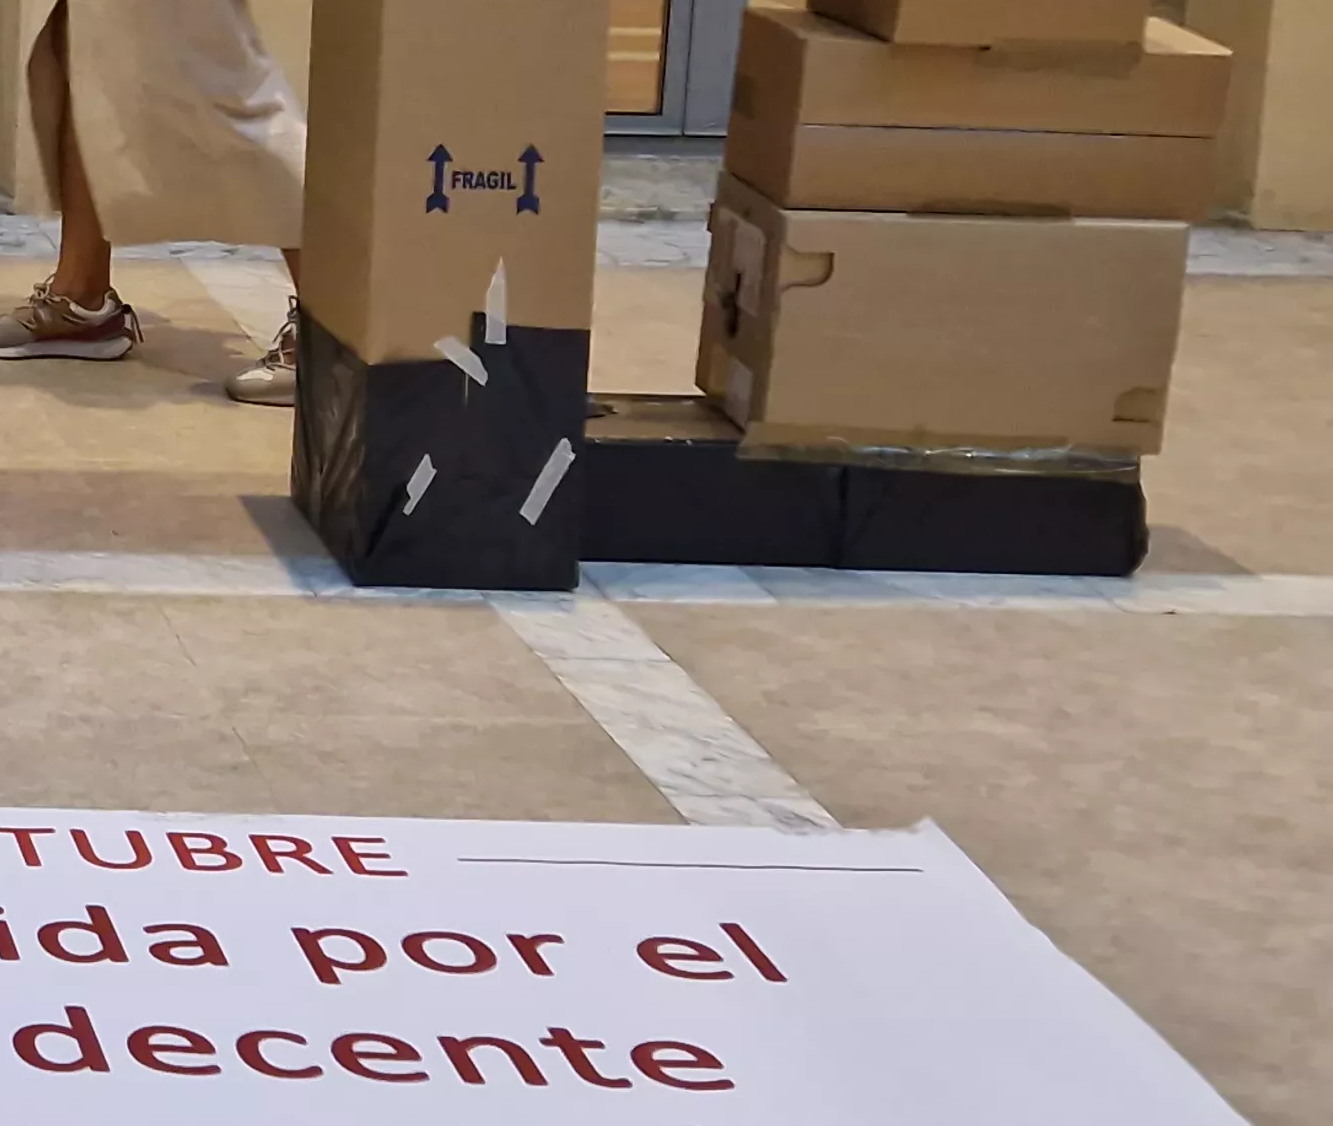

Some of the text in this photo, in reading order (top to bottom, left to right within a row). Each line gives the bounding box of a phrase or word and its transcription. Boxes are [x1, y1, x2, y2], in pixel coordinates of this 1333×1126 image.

[451, 170, 517, 191] FRAGIL
[292, 926, 566, 986] por
[635, 922, 788, 984] el
[11, 1005, 736, 1092] decente
